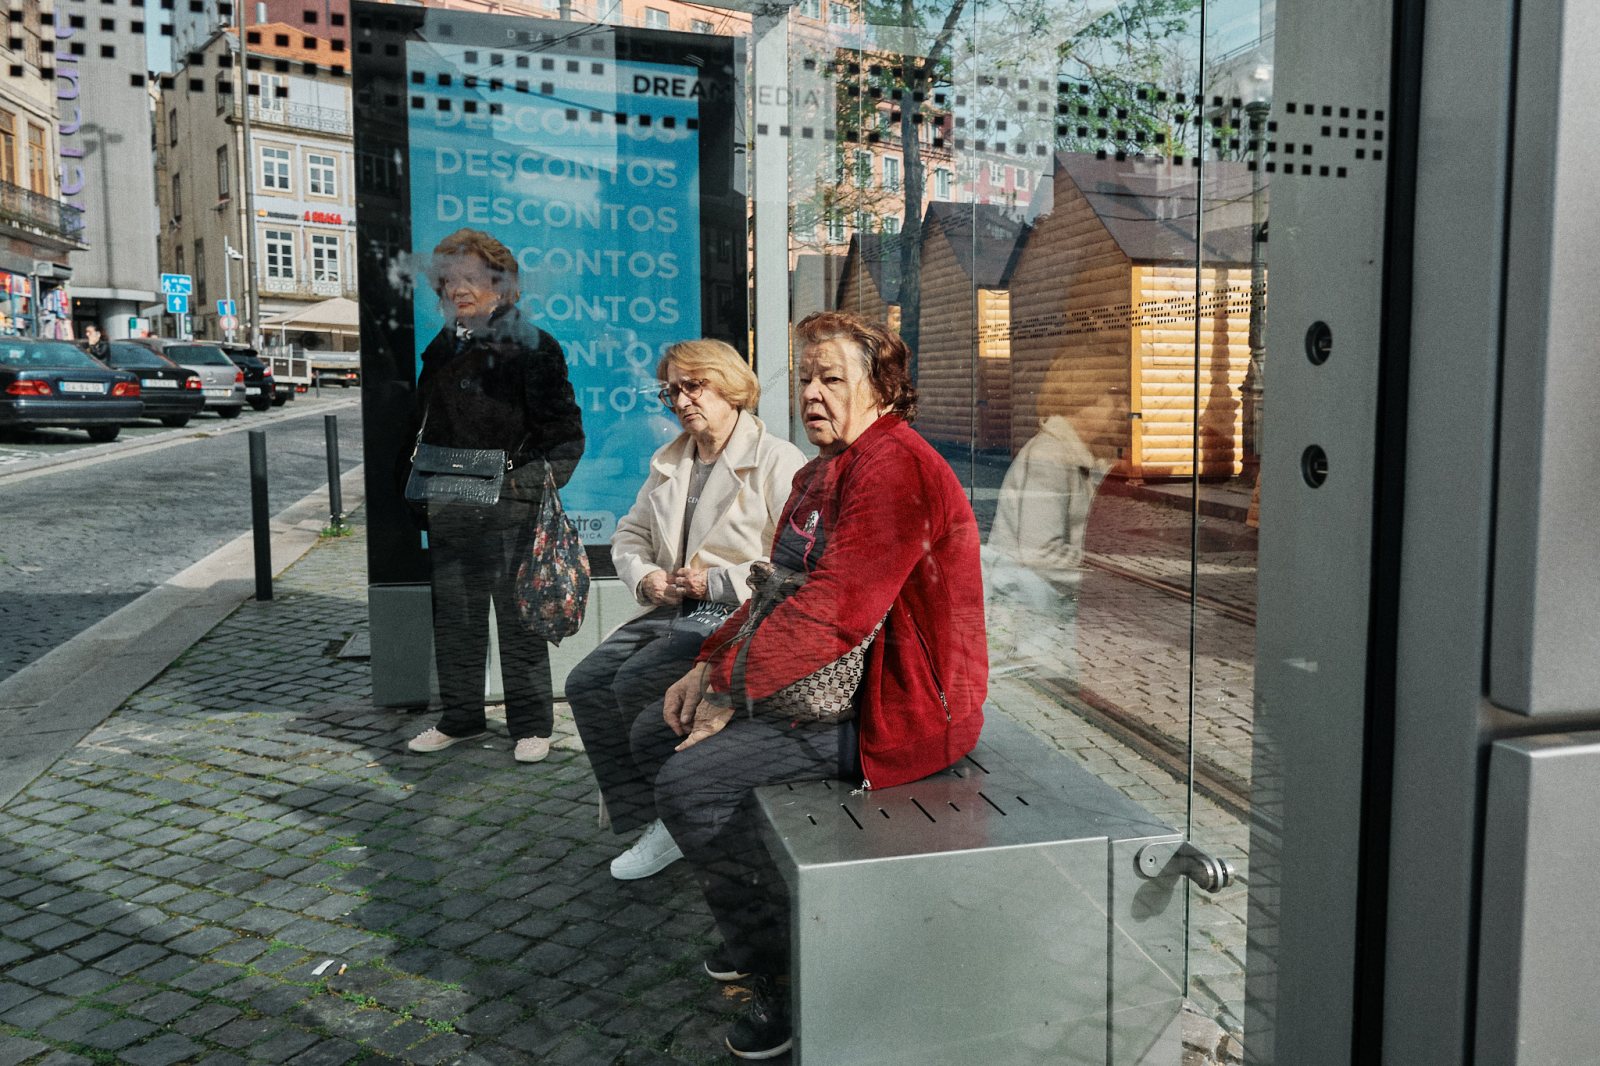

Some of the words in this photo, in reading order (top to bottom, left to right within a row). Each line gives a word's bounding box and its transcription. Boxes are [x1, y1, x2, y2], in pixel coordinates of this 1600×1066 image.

[435, 147, 678, 188] DESCONTOS
[437, 194, 678, 233] DESCONTOS
[517, 247, 679, 279] CONTOS
[520, 294, 680, 324] CONTOS
